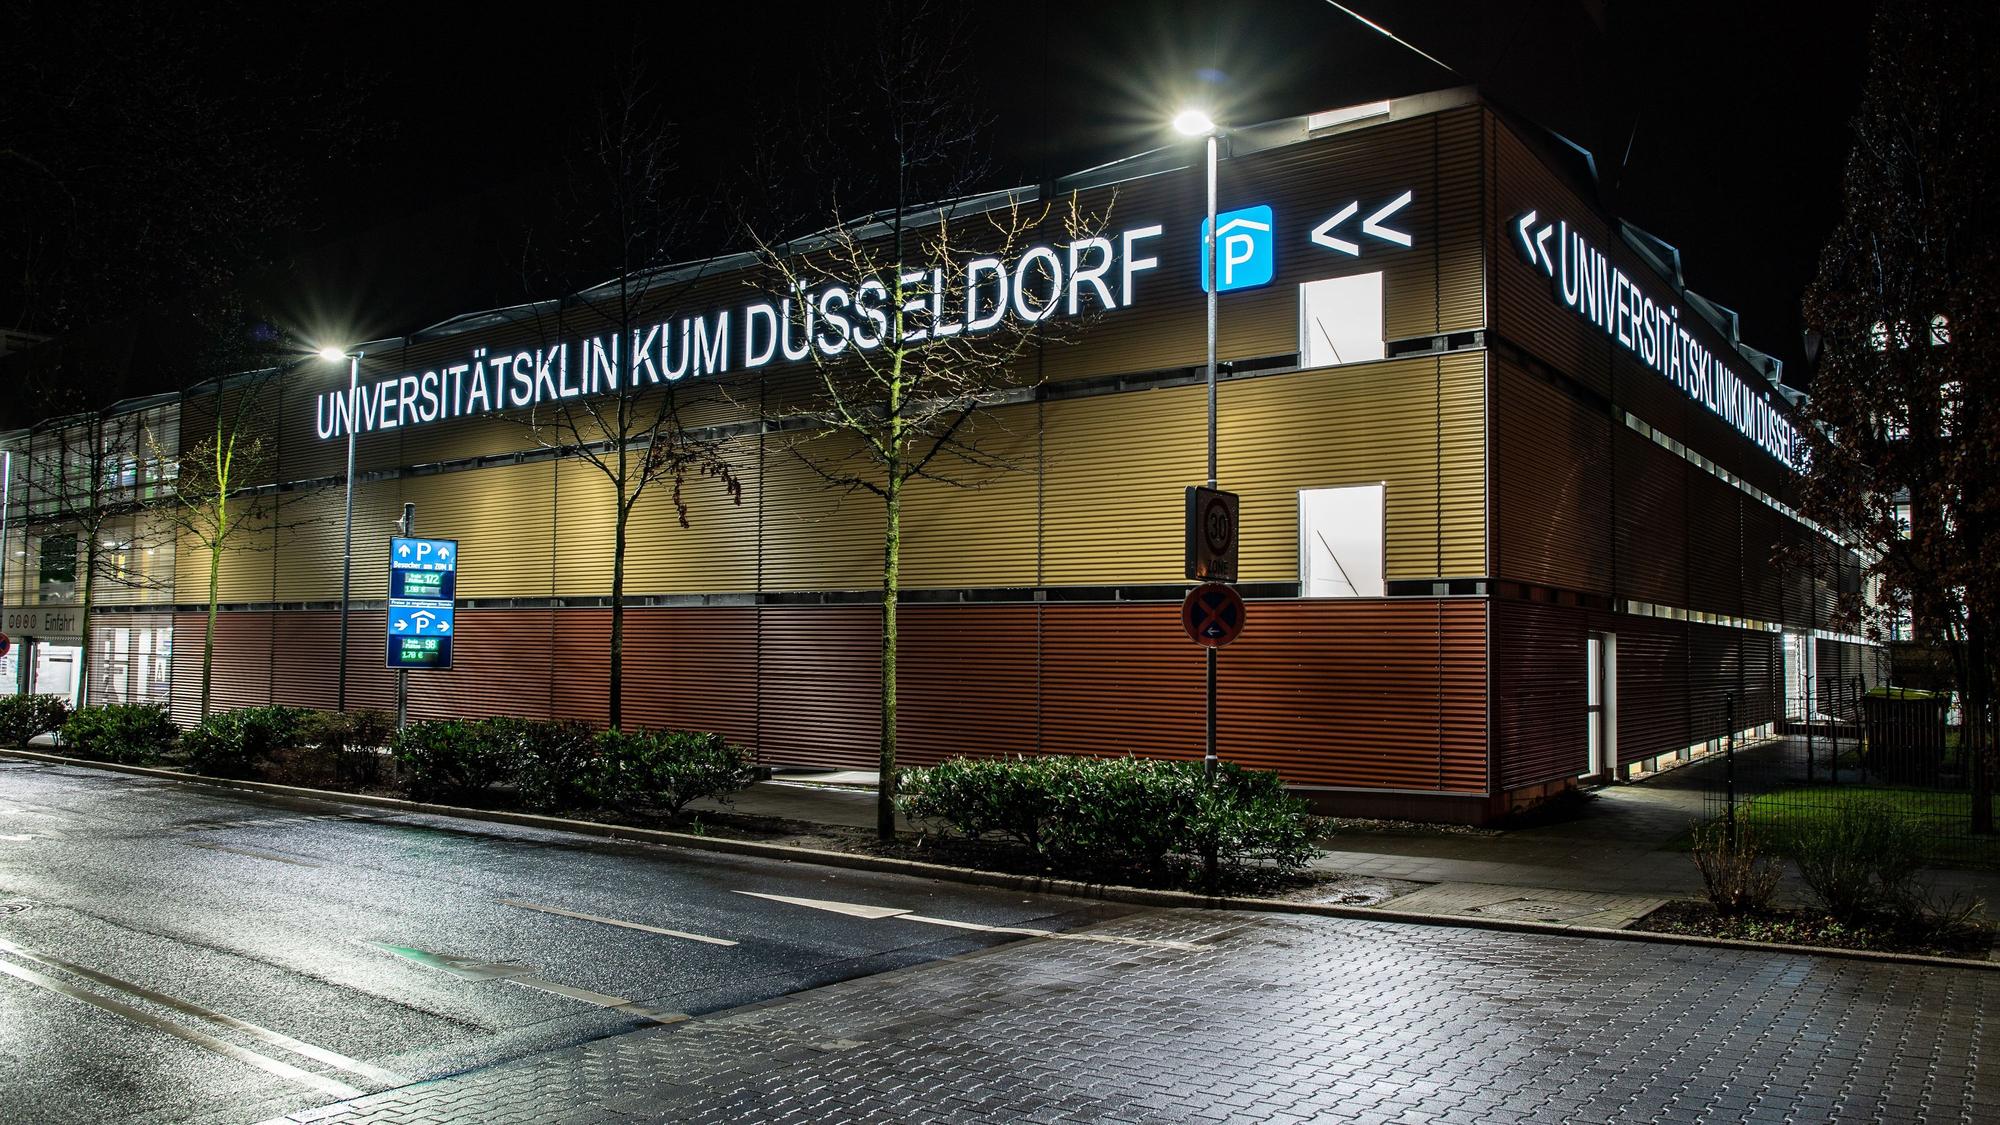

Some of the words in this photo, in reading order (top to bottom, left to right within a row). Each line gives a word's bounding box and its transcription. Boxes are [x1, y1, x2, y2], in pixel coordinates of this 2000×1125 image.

[1225, 233, 1255, 284] P
[317, 311, 728, 439] UNIVERSITÄTSKLINKUM
[745, 225, 1162, 367] DÜSSELDORF
[1561, 221, 1756, 441] UNIVERSITÄTSKLINIKUM
[1209, 512, 1227, 540] 30
[416, 542, 432, 561] P
[1207, 560, 1229, 576] ZONE
[45, 613, 75, 631] Einfahrt
[416, 617, 430, 634] P
